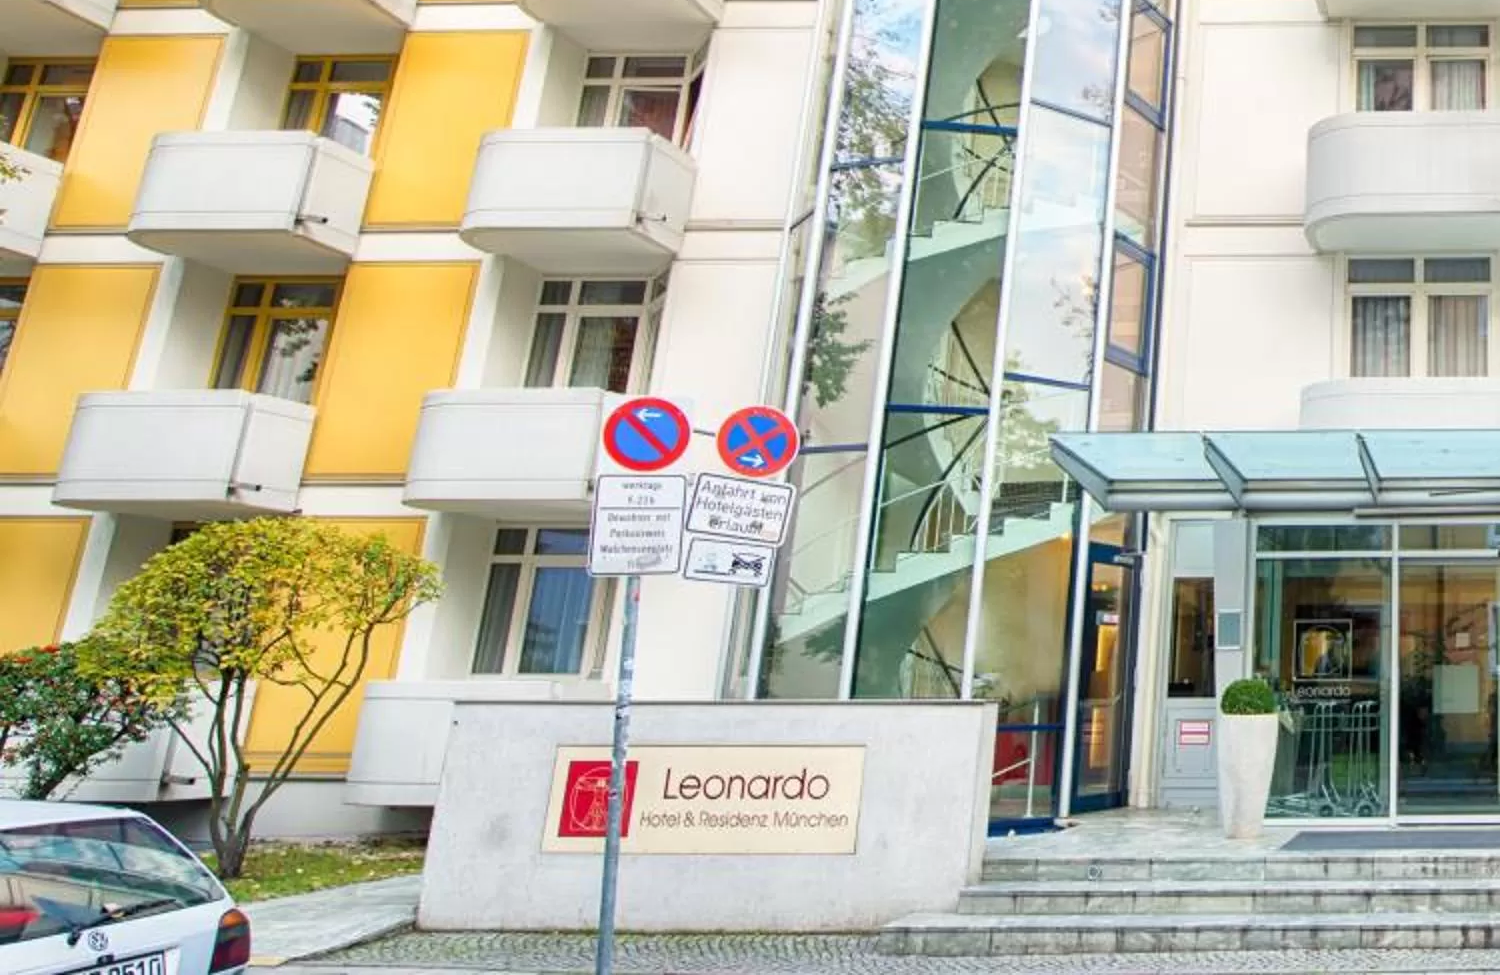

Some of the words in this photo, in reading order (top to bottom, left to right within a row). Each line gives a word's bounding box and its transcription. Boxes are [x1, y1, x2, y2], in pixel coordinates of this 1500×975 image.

[662, 768, 831, 800] Leonardo
[639, 810, 682, 827] Hotel
[683, 811, 696, 826] &
[698, 810, 768, 828] Residenz
[773, 810, 849, 828] München
